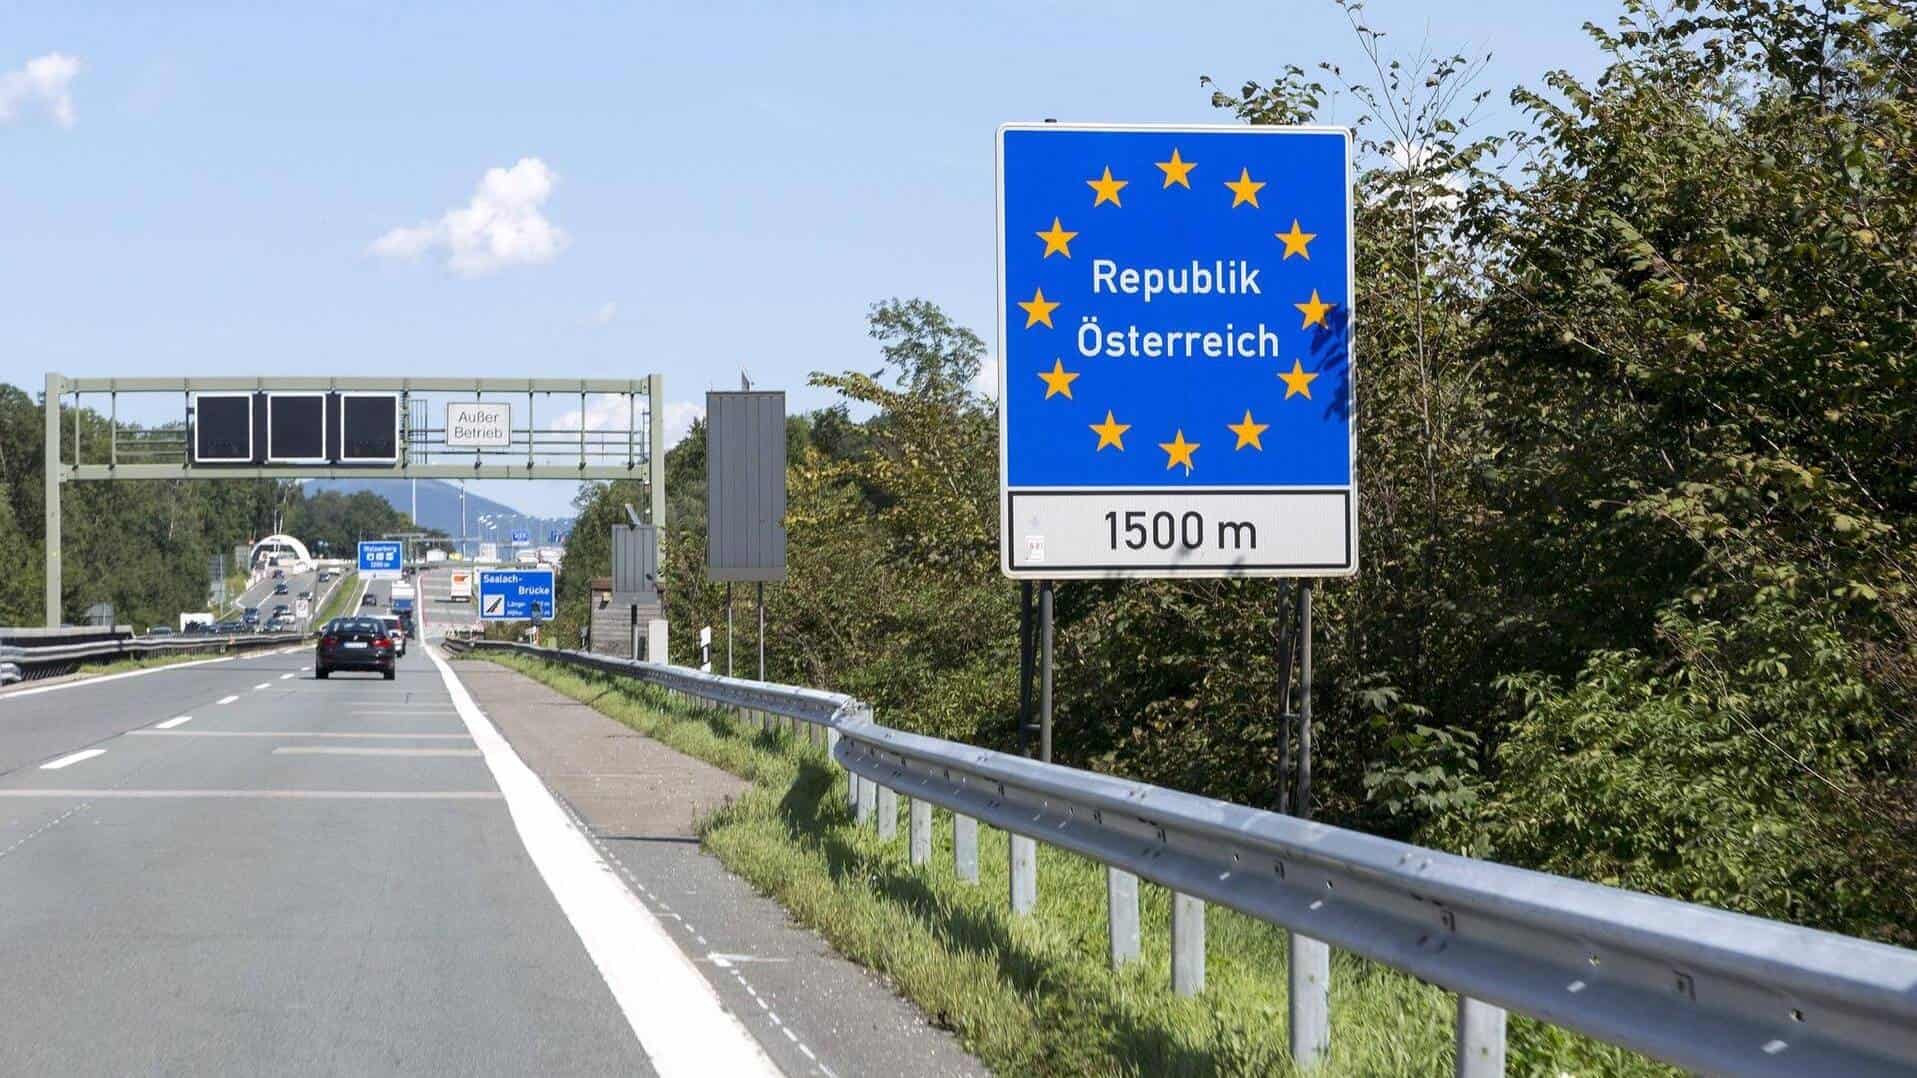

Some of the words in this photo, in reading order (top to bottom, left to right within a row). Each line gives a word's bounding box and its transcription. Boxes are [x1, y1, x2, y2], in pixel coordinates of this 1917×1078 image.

[1092, 259, 1262, 302] Republik
[1077, 316, 1280, 358] Österreich
[458, 411, 499, 423] Außer
[454, 426, 503, 439] Betrieb
[1104, 510, 1204, 550] 1500
[1218, 519, 1258, 549] m
[483, 574, 523, 583] Saalach-
[518, 585, 550, 595] Brücke
